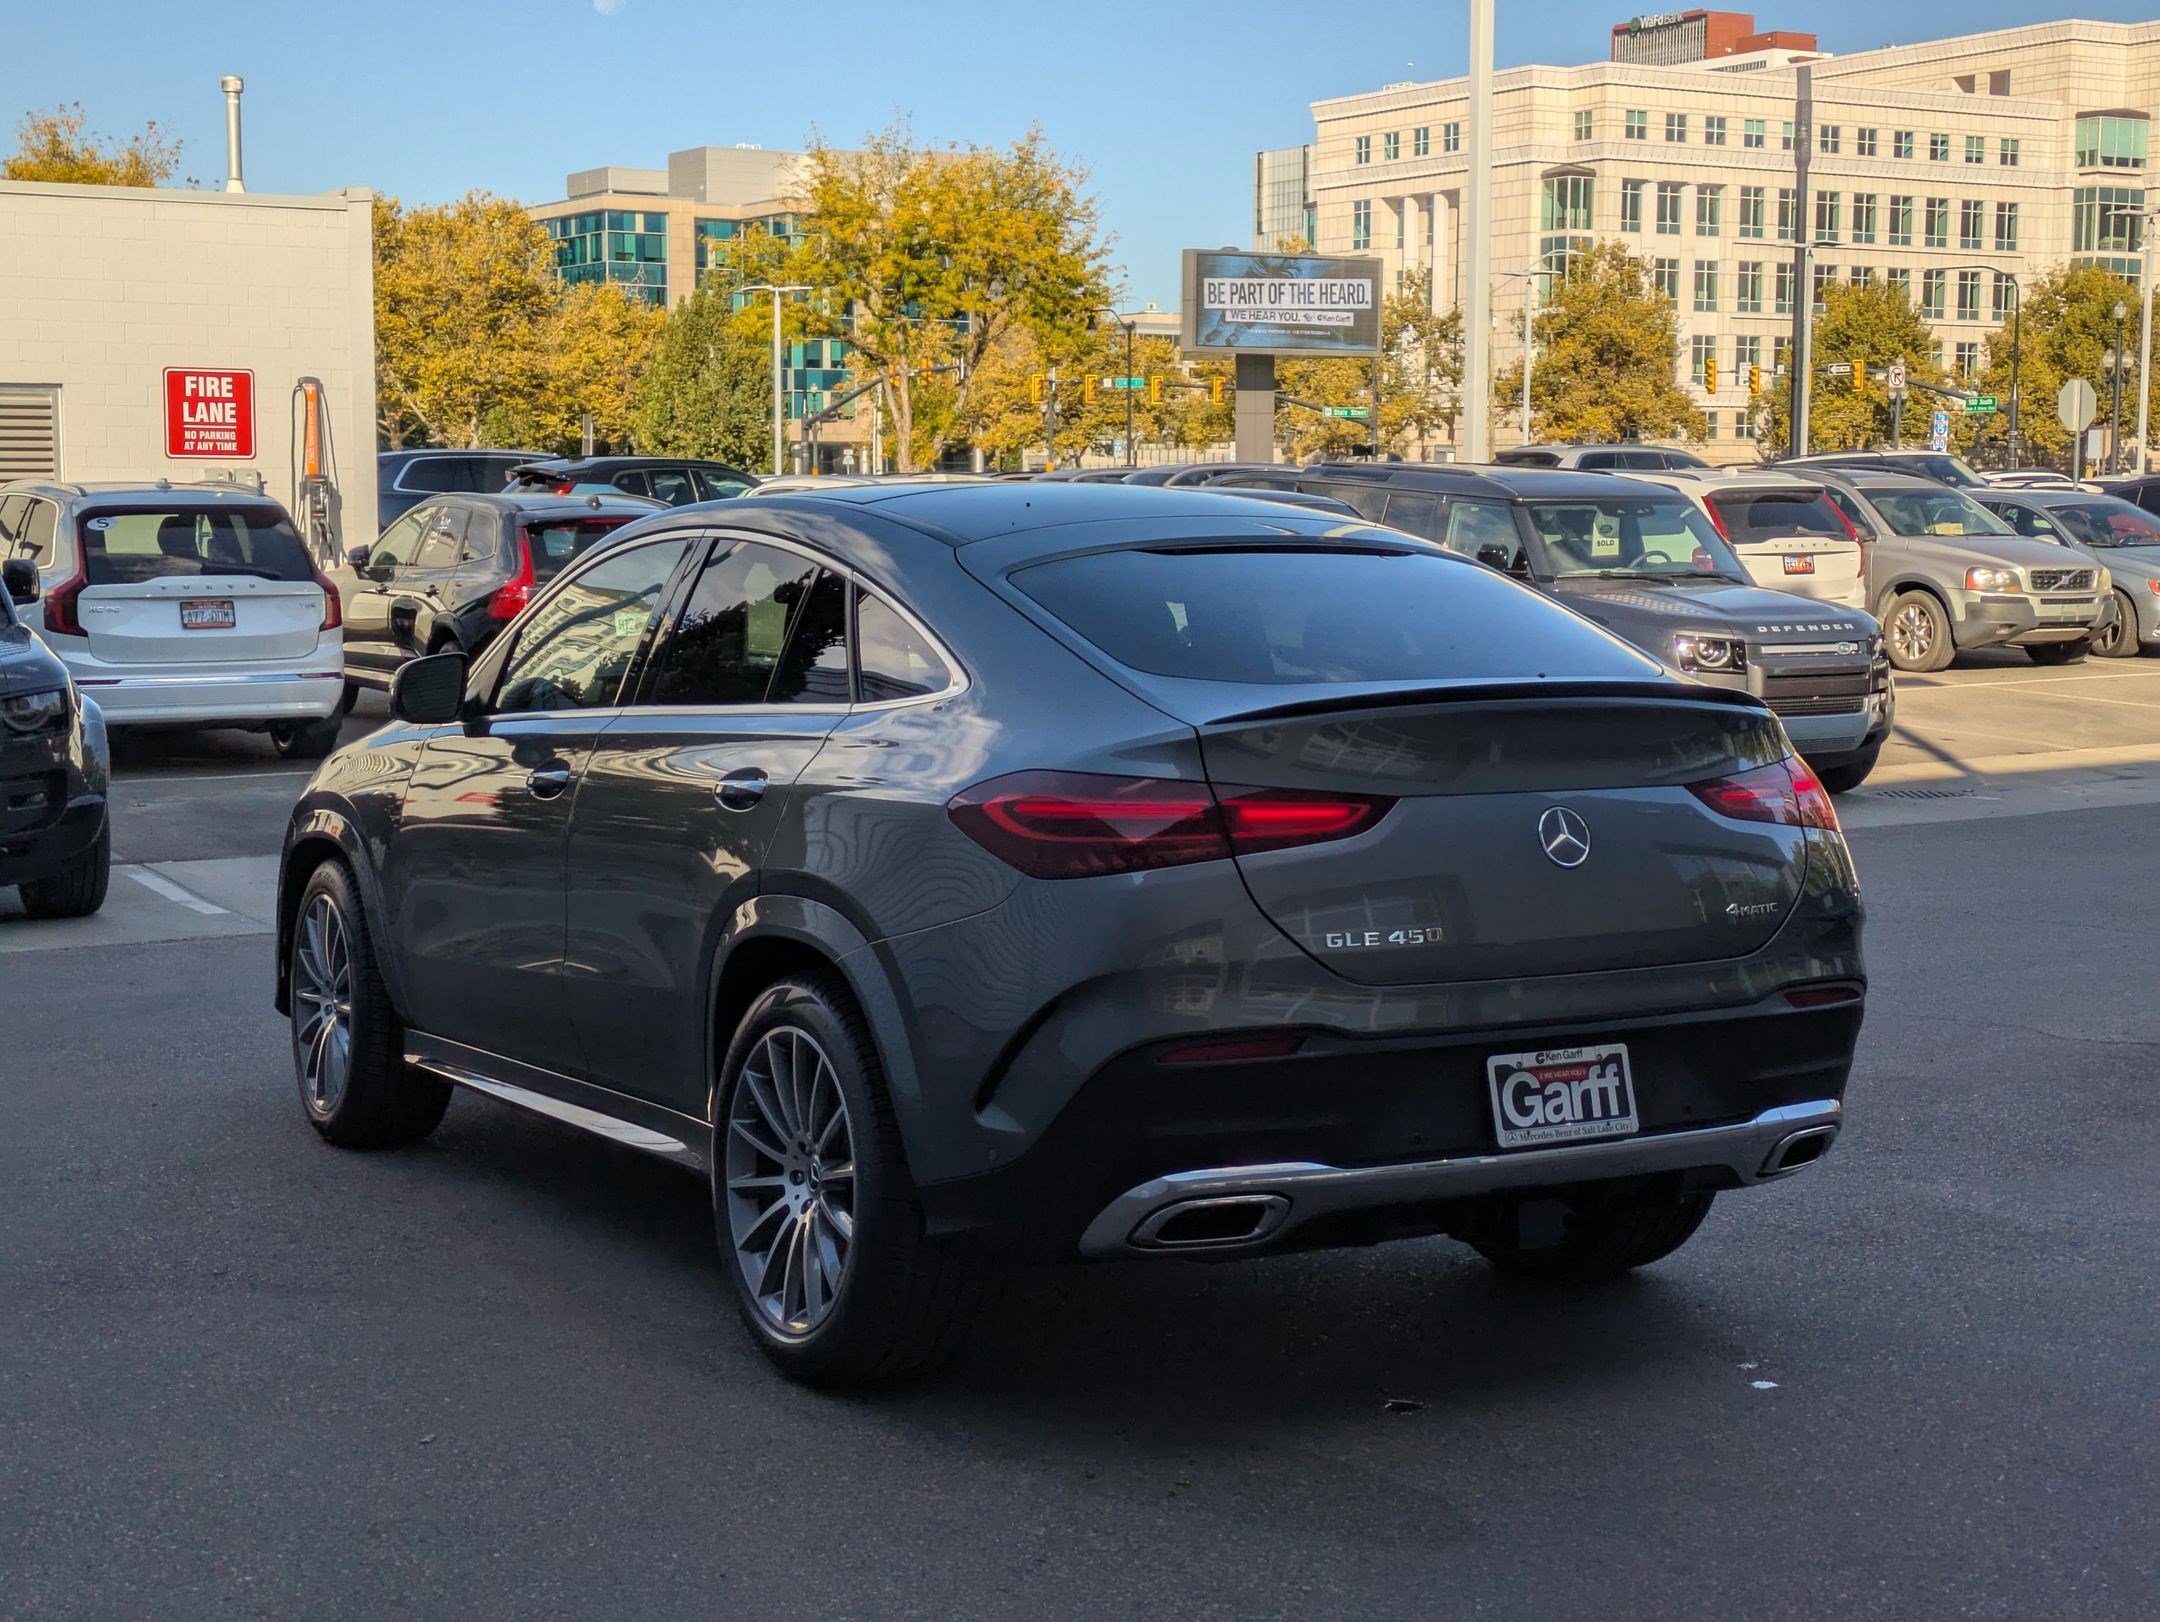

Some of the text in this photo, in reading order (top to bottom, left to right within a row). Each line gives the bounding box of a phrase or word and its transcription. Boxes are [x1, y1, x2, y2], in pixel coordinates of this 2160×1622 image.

[1208, 282, 1369, 305] BE PART OF THE HEARD.
[1230, 310, 1300, 322] WE HEAR YOU.
[184, 375, 234, 398] FIRE
[182, 401, 237, 423] LANE
[184, 431, 236, 440] NO PARKING
[183, 441, 237, 451] AT ANY TIME
[1597, 539, 1615, 547] SOLD
[1757, 623, 1855, 633] DEFENDER
[1725, 902, 1778, 916] 4MATIC
[1325, 927, 1443, 948] GLE 450
[1545, 1049, 1583, 1061] Ken Garff
[1502, 1062, 1620, 1127] Garff
[1573, 1126, 1581, 1137] of
[1582, 1125, 1596, 1136] Salt
[1597, 1122, 1614, 1134] Lake
[1615, 1120, 1631, 1133] City
